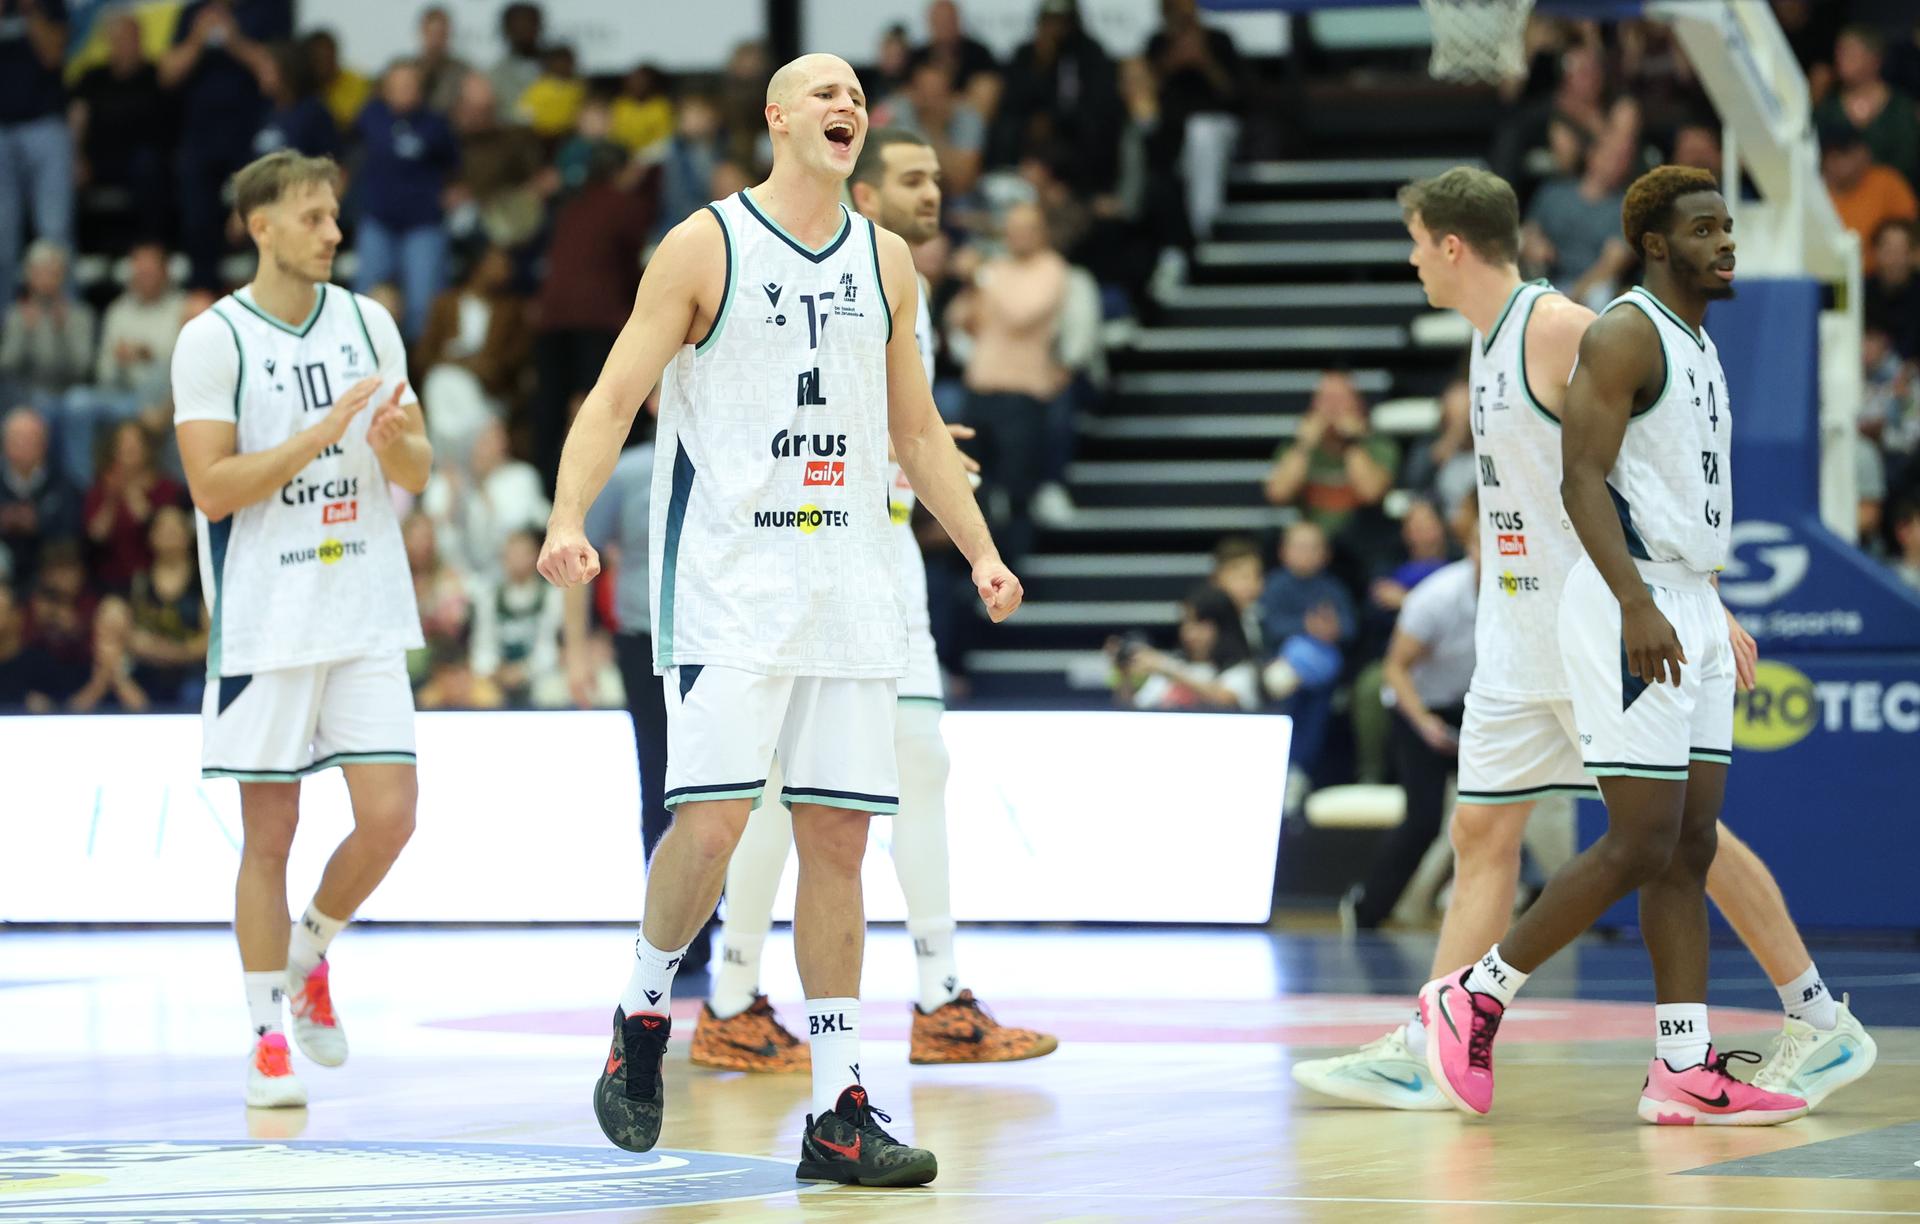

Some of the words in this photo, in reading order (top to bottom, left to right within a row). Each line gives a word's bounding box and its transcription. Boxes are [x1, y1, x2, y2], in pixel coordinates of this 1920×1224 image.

[293, 362, 332, 412] 10
[281, 478, 358, 506] Circus
[1734, 680, 1920, 733] ROTEC
[1482, 955, 1508, 991] BXL
[1803, 979, 1822, 1002] BX
[809, 1013, 853, 1036] BXL
